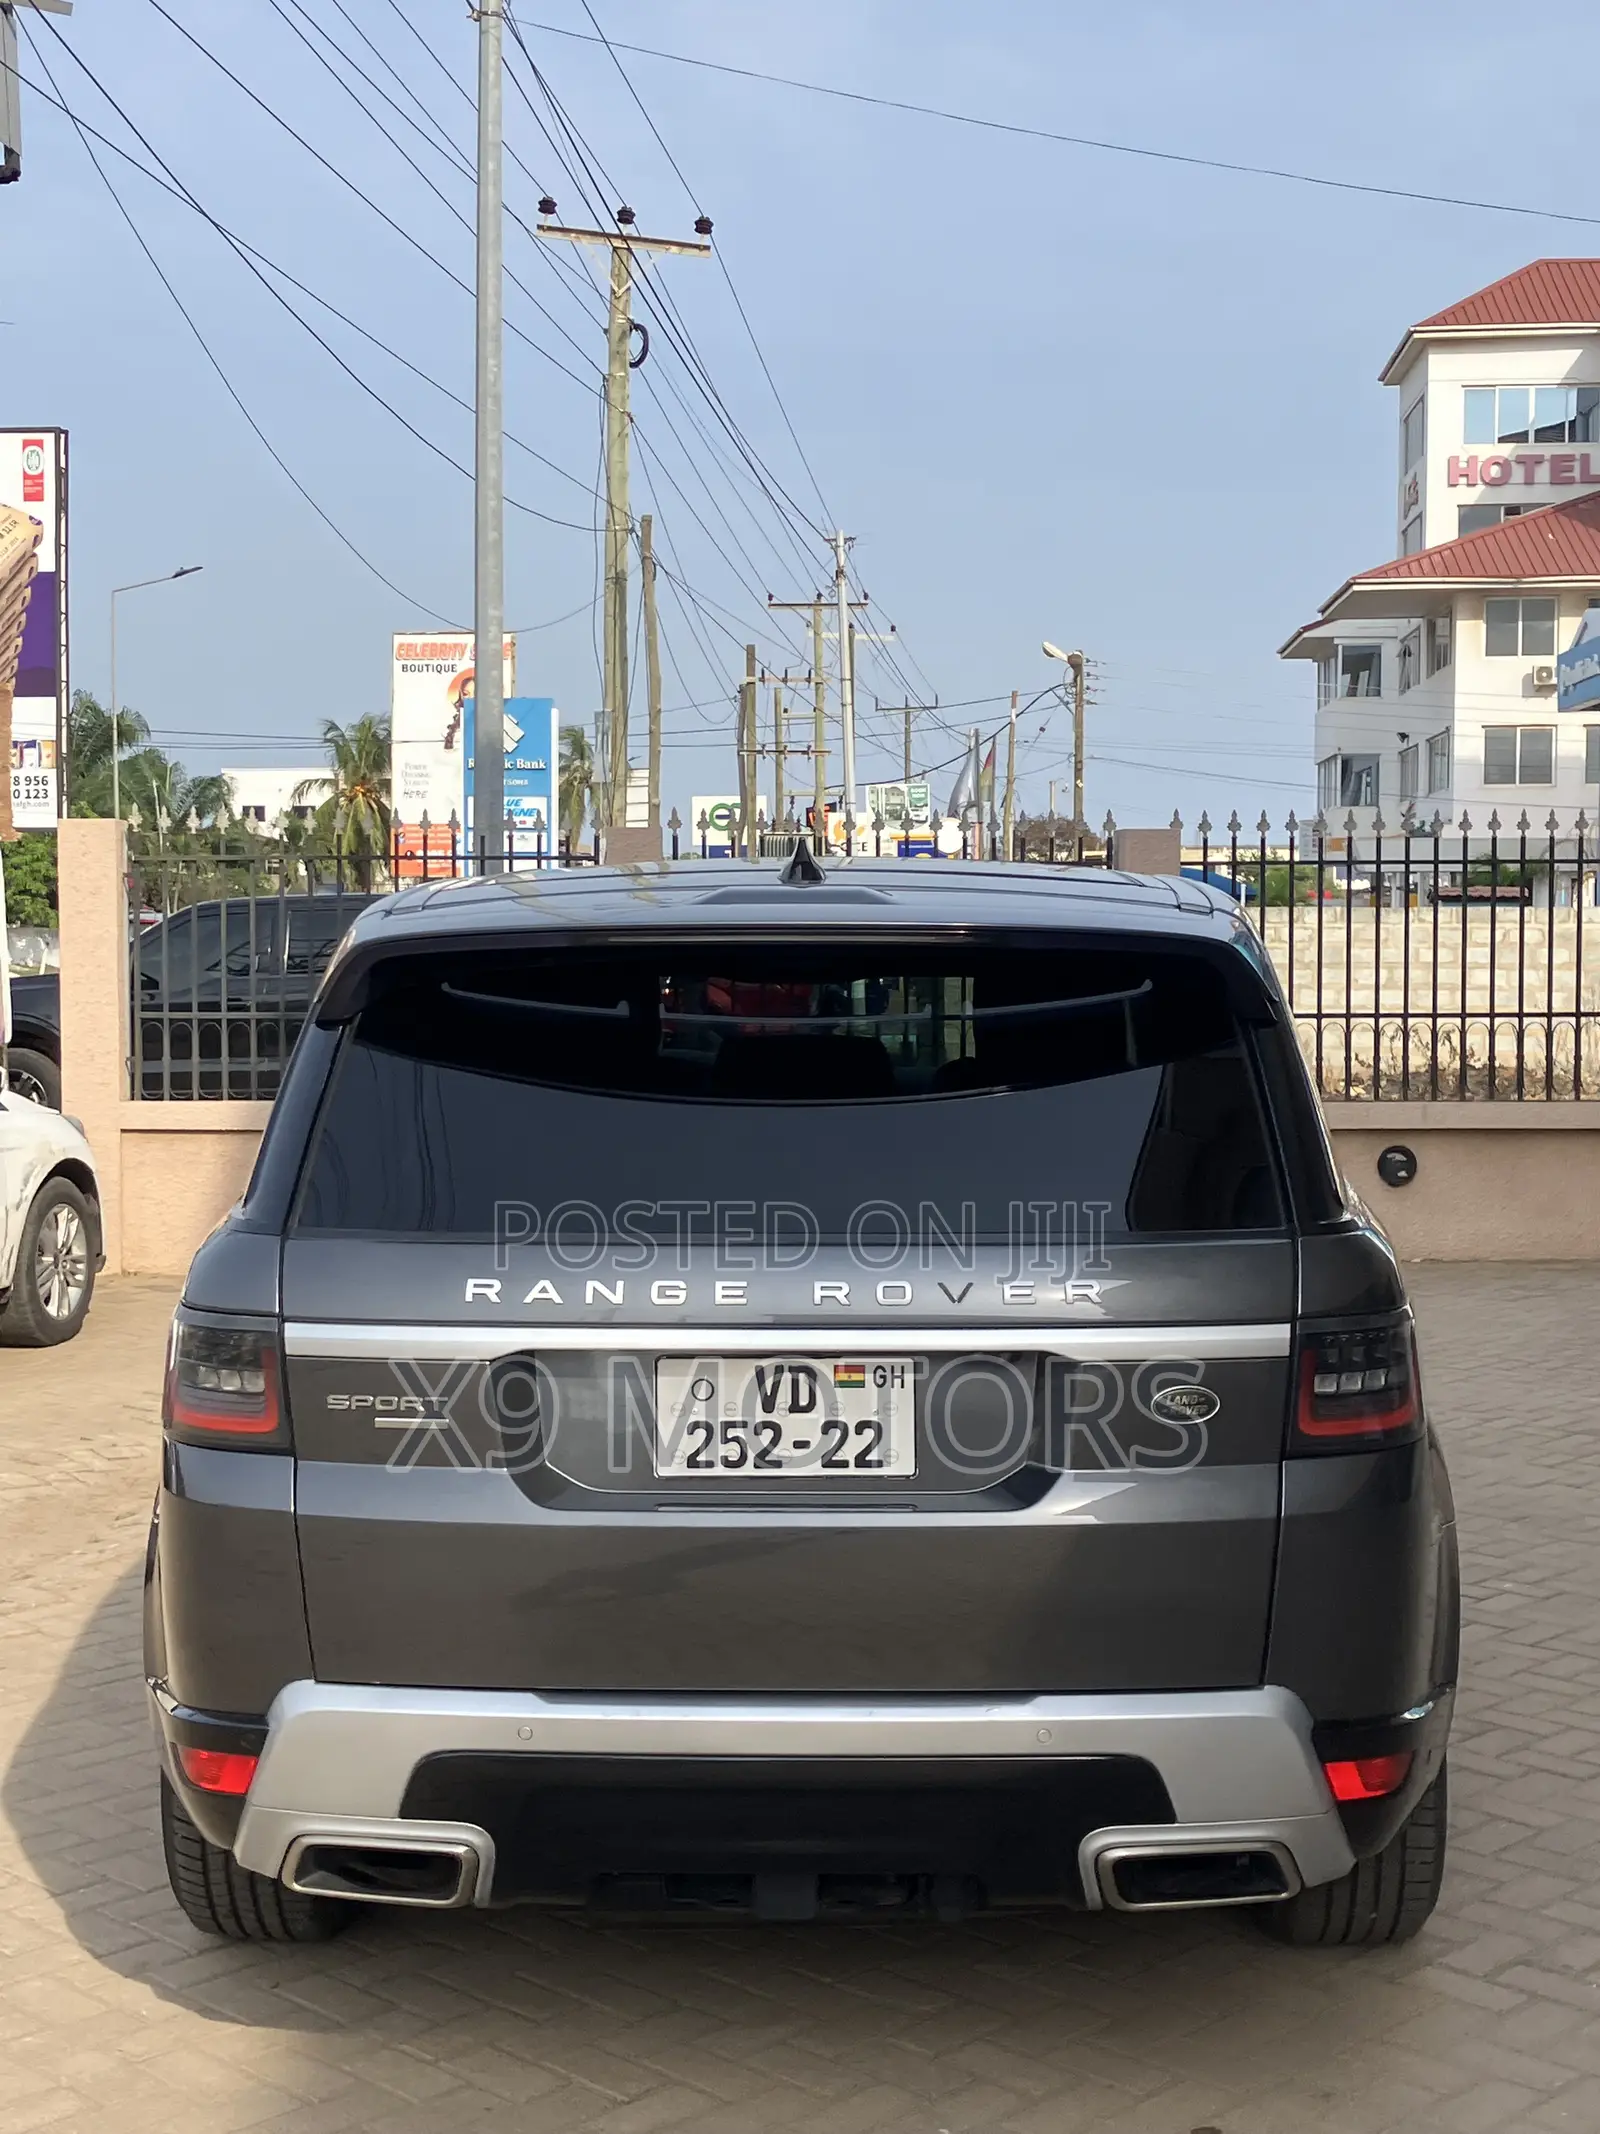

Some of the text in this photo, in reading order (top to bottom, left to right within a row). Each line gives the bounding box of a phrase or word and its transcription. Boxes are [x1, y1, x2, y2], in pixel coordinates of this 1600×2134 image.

[1448, 453, 1600, 488] HOTEL
[396, 642, 468, 660] CELEBRITY
[401, 663, 458, 674] BOUTIQUE
[516, 758, 547, 769] Bank
[24, 775, 49, 786] 956
[24, 788, 49, 800] 123
[464, 1278, 1103, 1306] RANGE ROVER
[755, 1363, 906, 1414] VD GH
[326, 1394, 449, 1411] SPORT
[686, 1419, 884, 1469] 252-22
